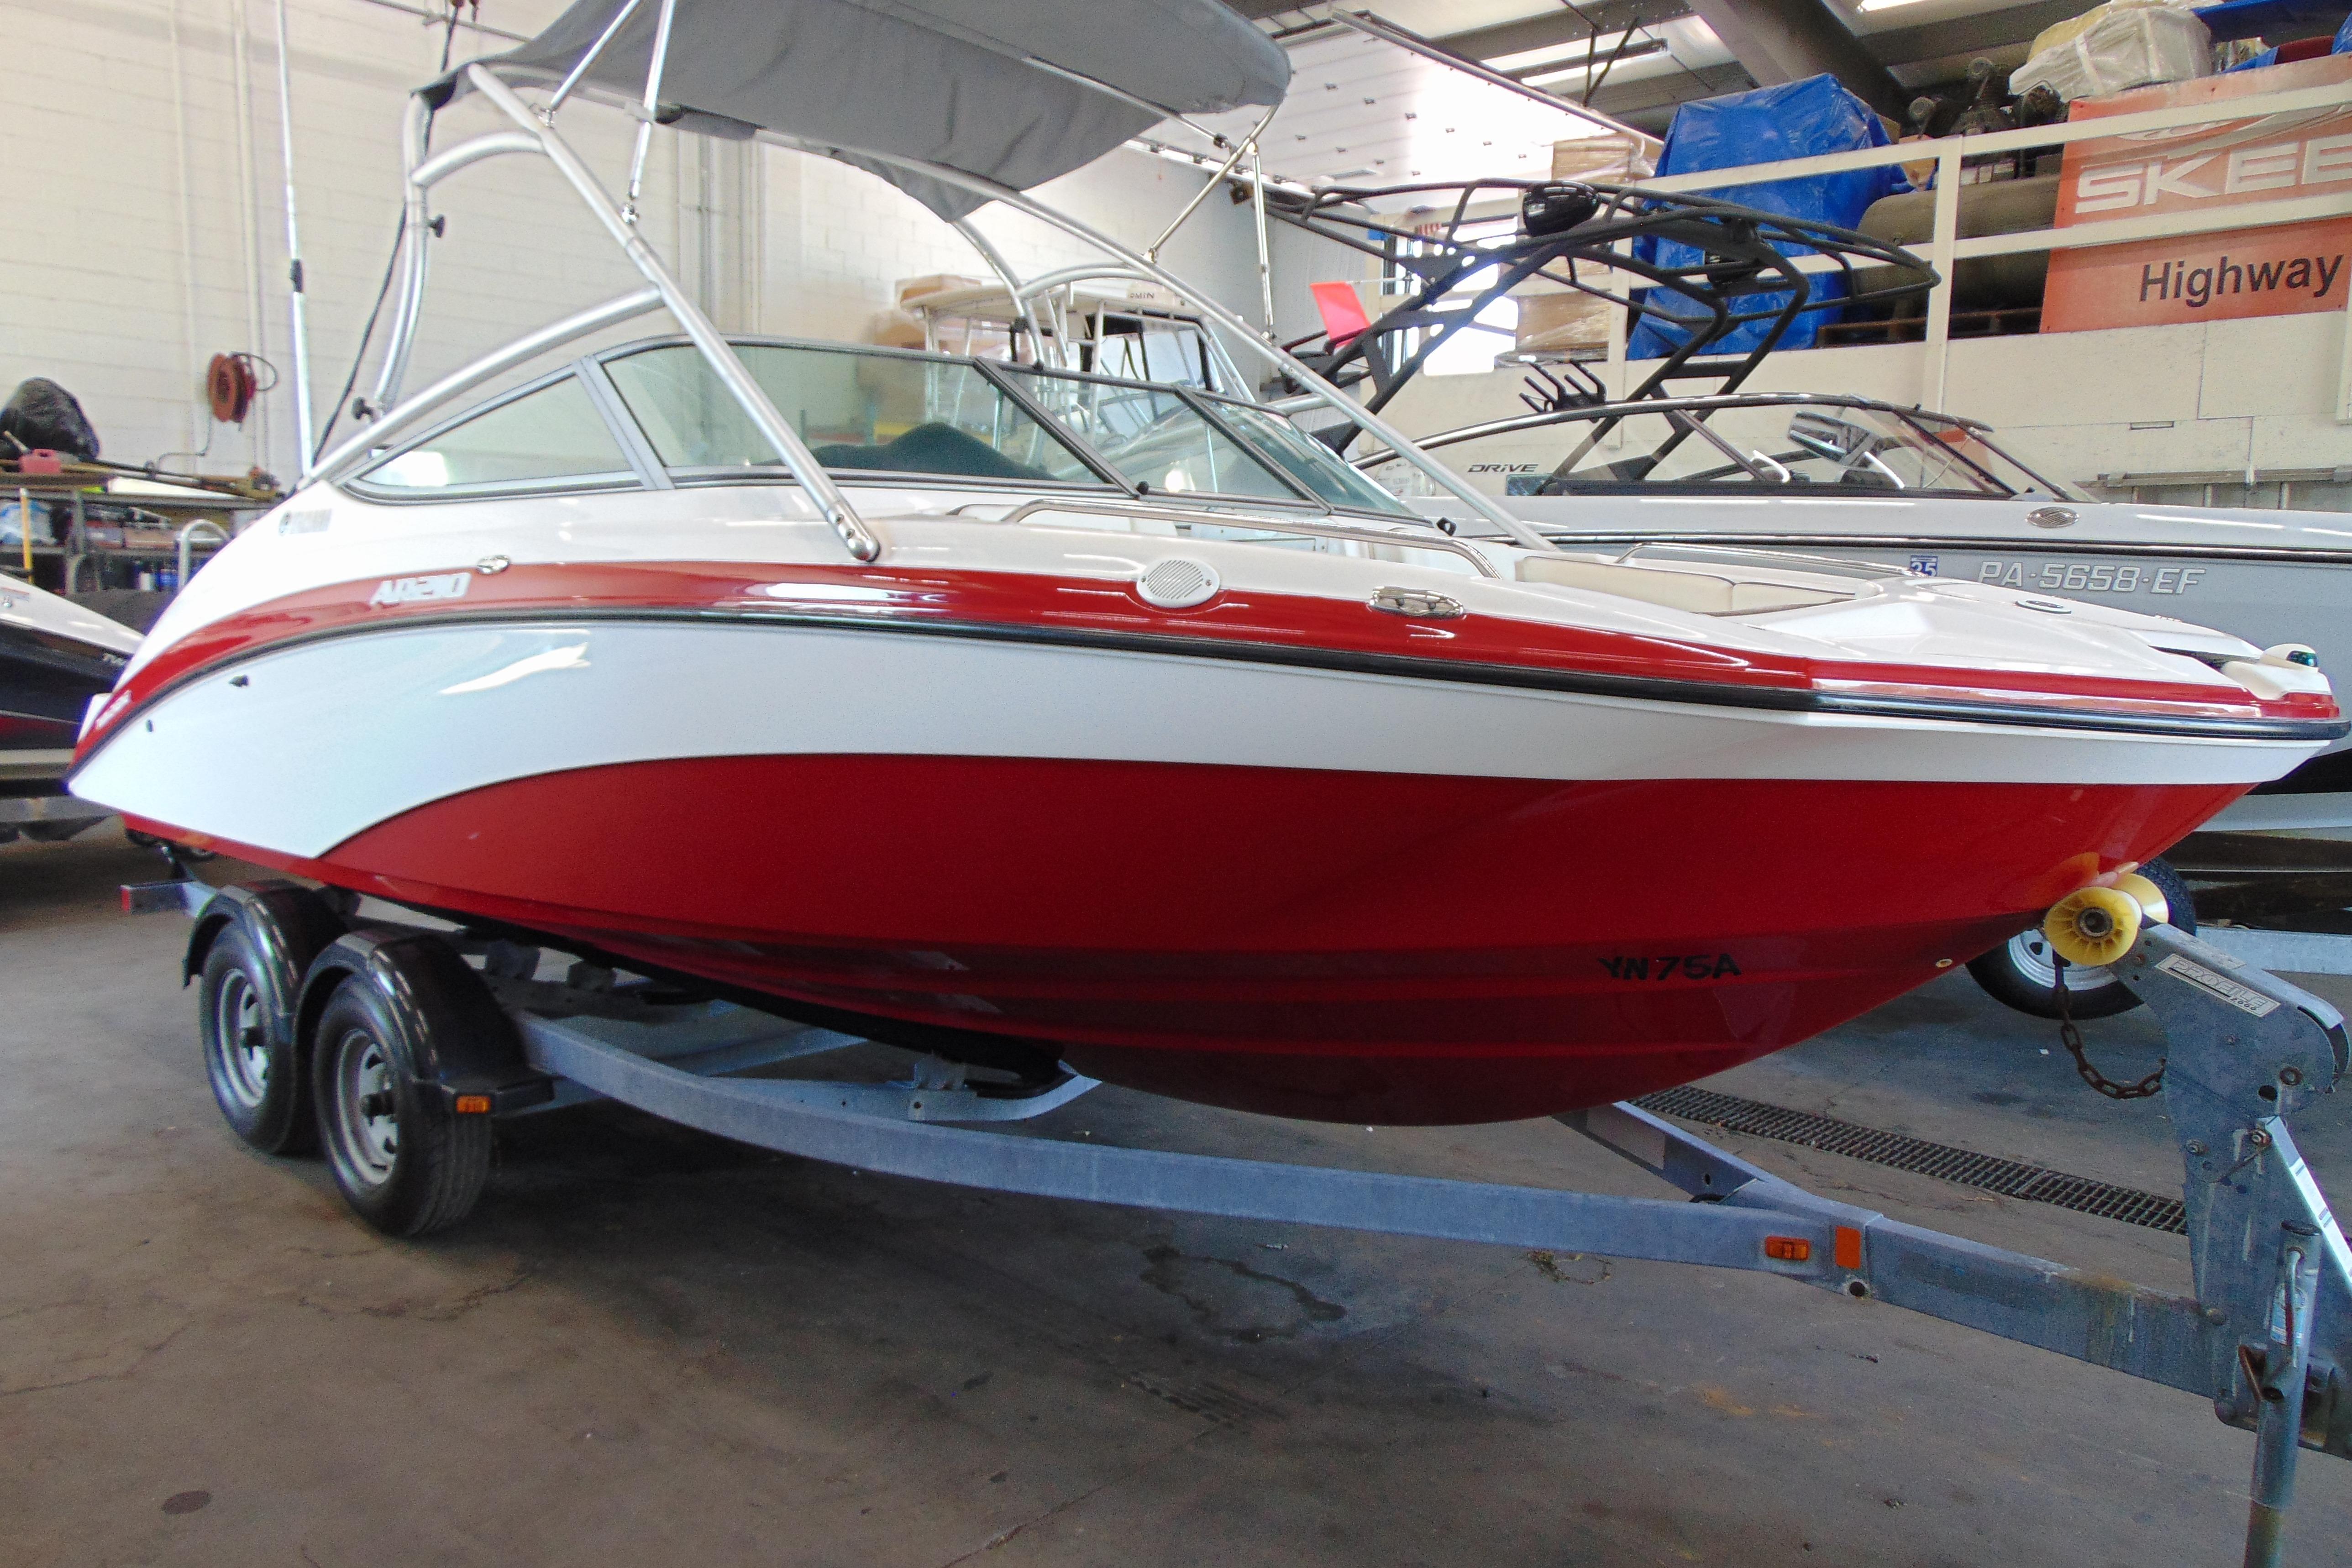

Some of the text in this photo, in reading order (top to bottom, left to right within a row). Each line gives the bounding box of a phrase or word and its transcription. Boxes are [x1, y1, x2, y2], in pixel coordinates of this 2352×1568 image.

[2075, 133, 2352, 214] SKEE
[2139, 254, 2344, 308] Highway
[2171, 959, 2269, 1008] PROFILE
[2230, 997, 2257, 1011] 2000
